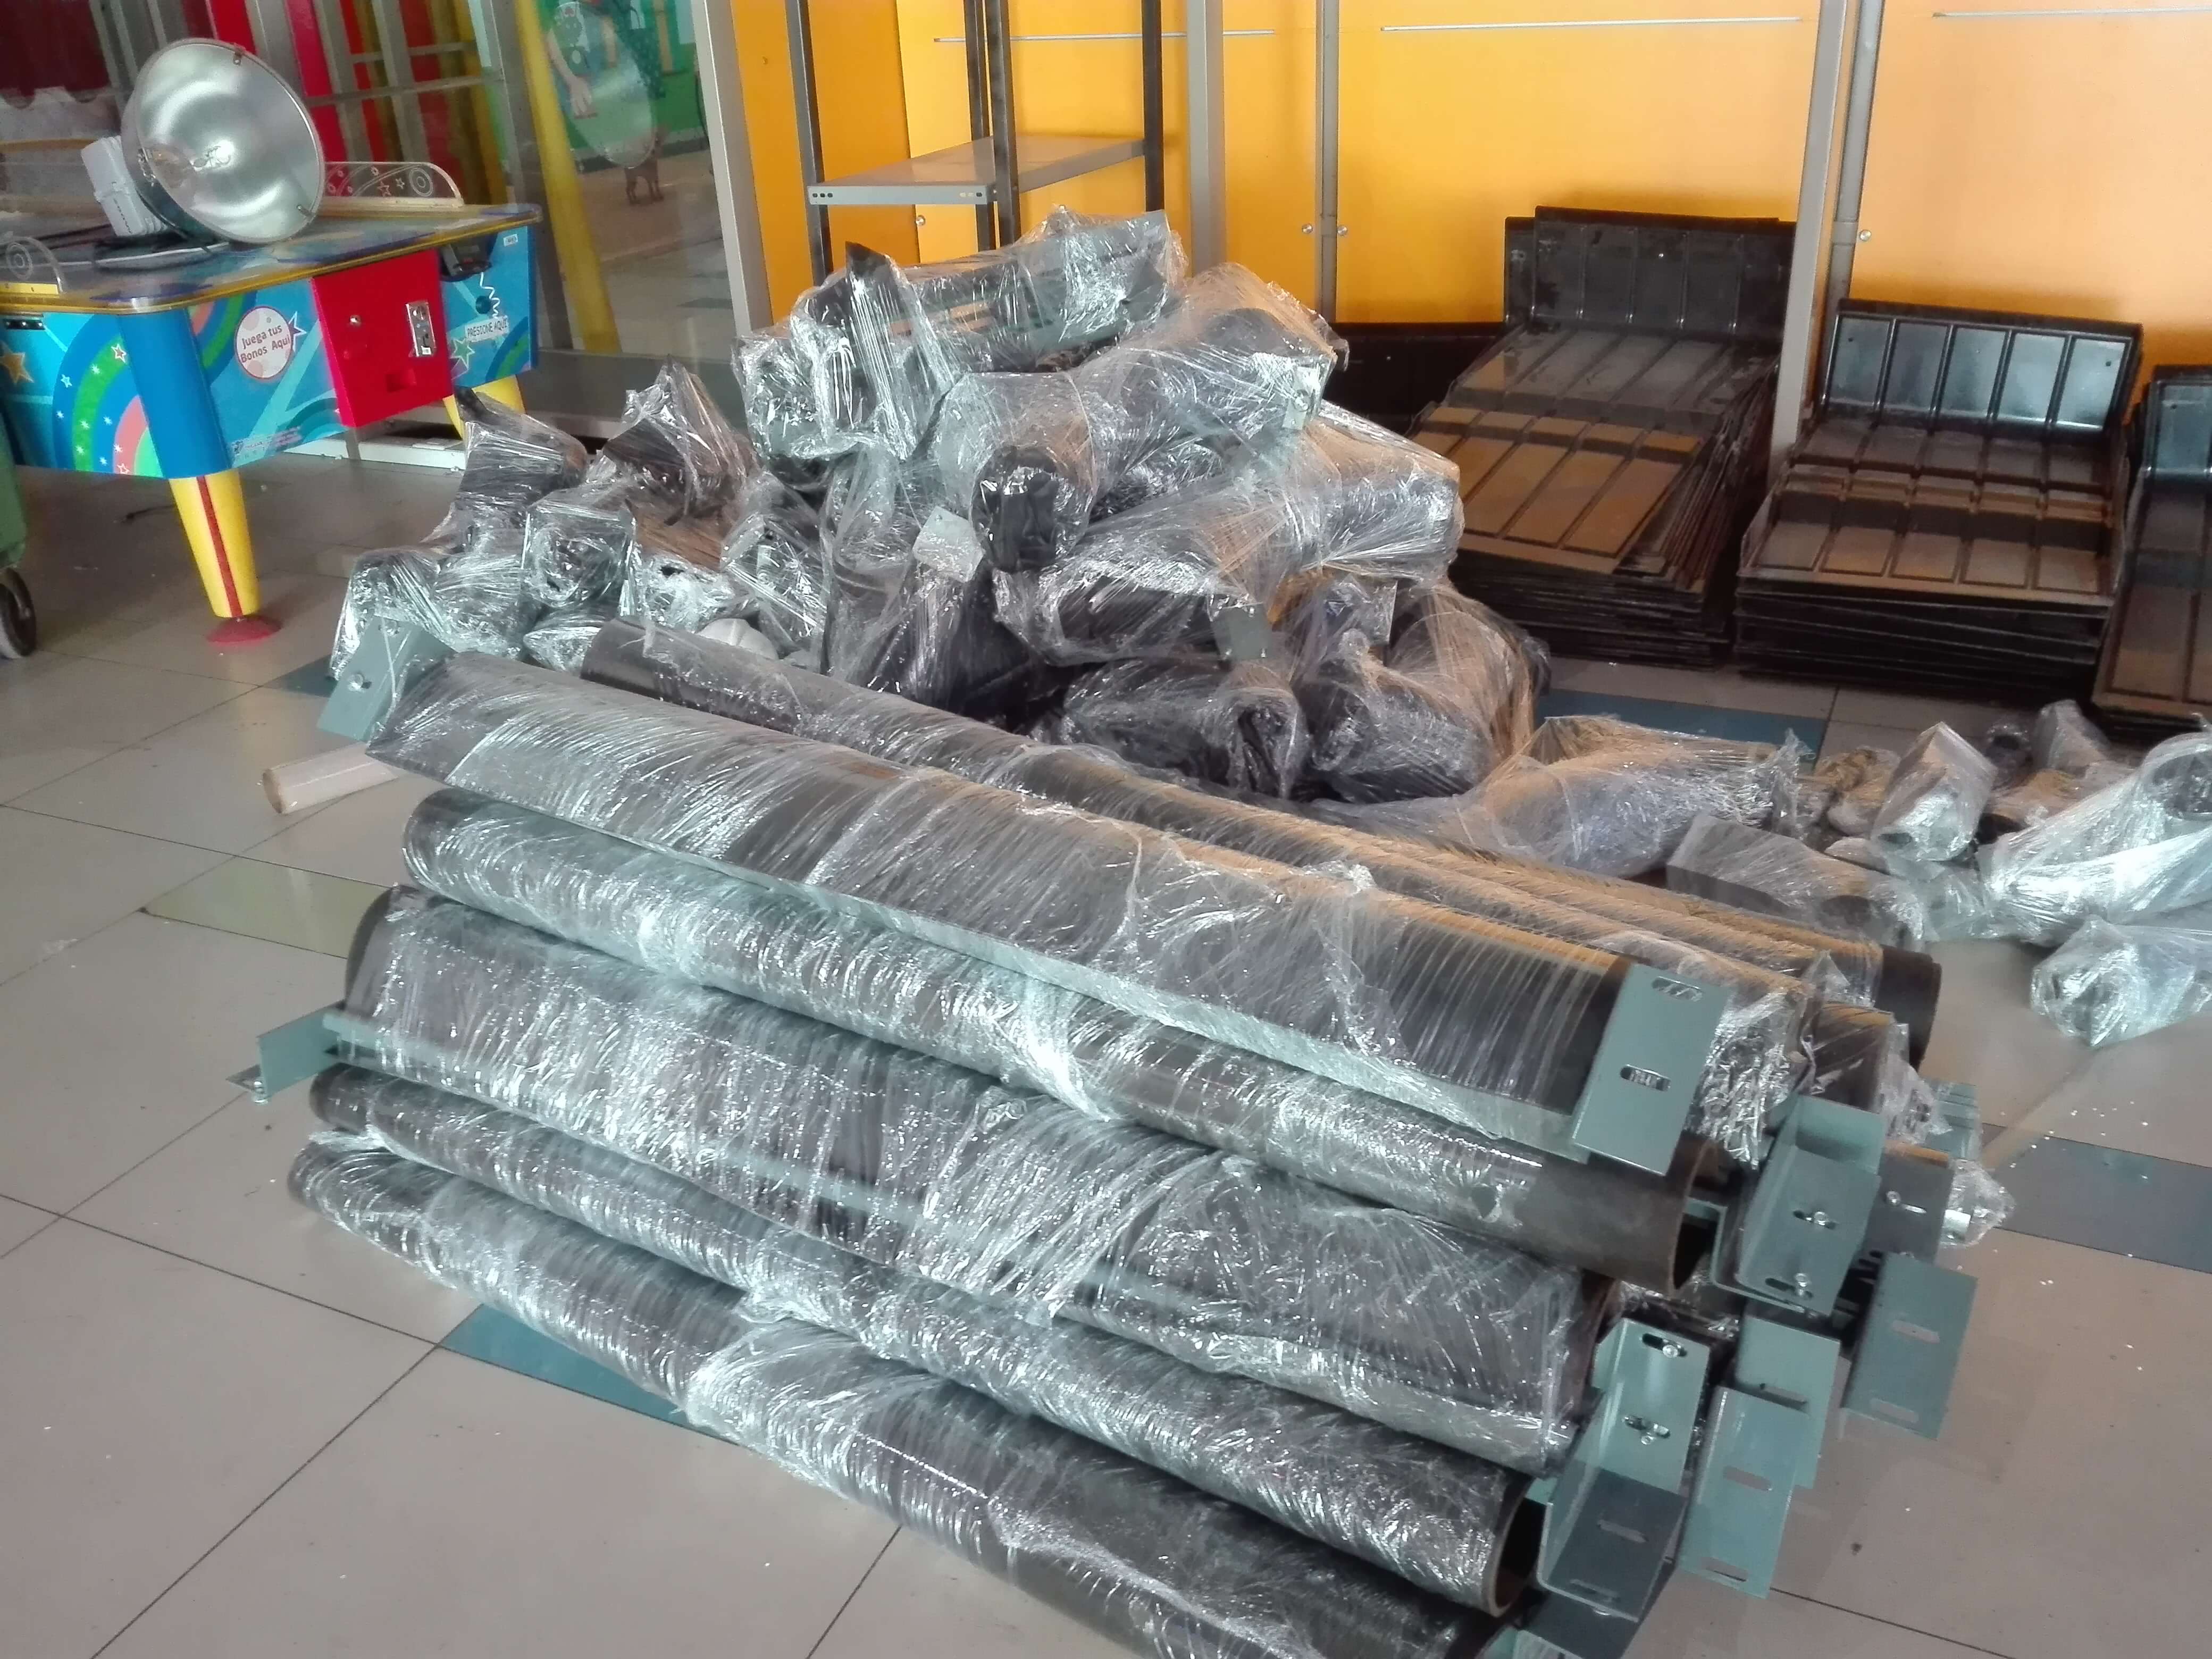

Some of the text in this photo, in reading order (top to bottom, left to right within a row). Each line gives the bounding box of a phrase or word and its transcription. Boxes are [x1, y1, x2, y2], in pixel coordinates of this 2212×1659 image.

[241, 325, 282, 349] Juega tus
[467, 322, 493, 337] PRESIONE
[240, 346, 267, 363] Bonos
